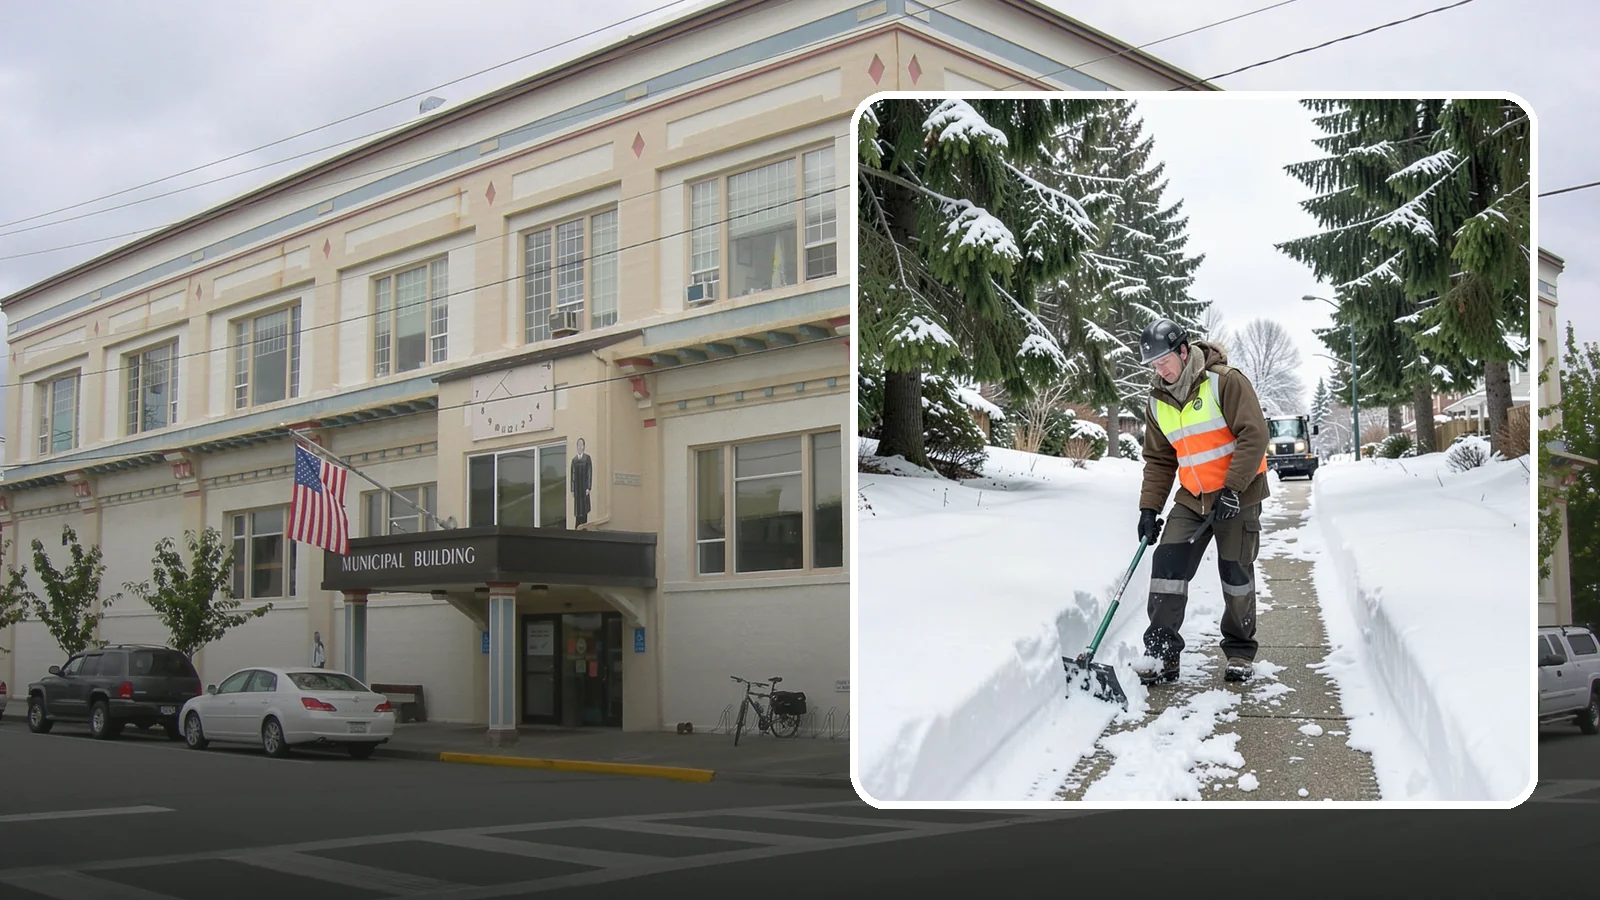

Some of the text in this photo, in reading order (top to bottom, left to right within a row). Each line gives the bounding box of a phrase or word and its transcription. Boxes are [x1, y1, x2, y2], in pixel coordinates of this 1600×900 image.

[536, 402, 540, 410] 4
[480, 407, 485, 415] 8
[488, 418, 492, 426] 9
[528, 414, 533, 422] 3
[521, 420, 526, 428] 2
[508, 426, 514, 434] 12
[342, 546, 475, 572] MUNICIPAL BUILDING
